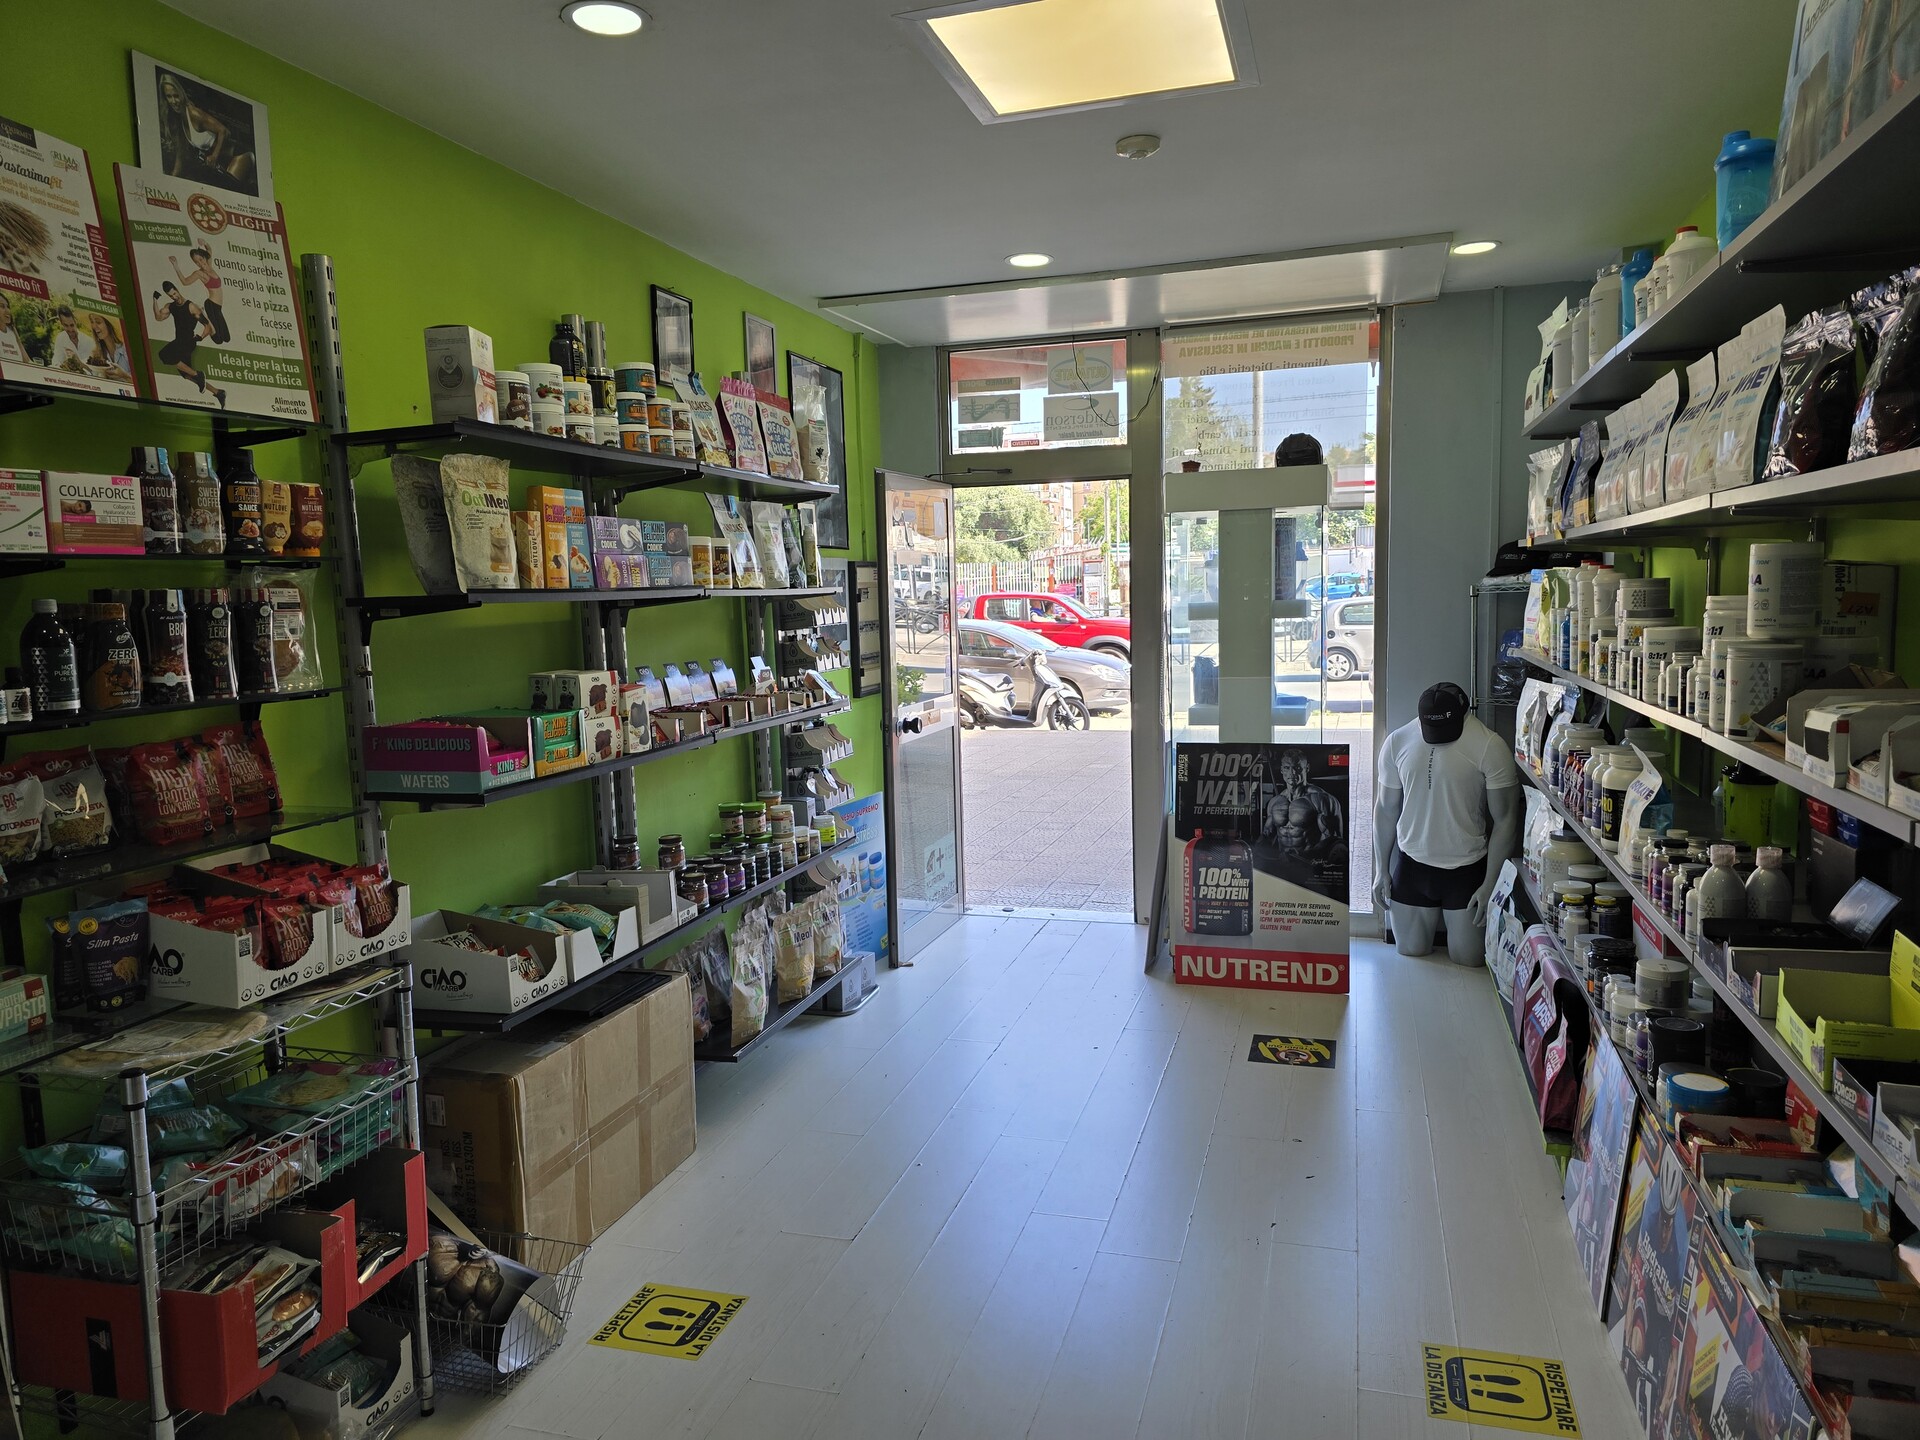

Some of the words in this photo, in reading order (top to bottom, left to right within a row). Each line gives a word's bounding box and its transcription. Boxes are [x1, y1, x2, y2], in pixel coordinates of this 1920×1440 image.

[145, 187, 178, 202] RIMA
[133, 222, 143, 231] ha
[148, 224, 184, 235] carboidrati
[231, 214, 275, 232] LIGHT
[227, 241, 280, 261] Immagina
[213, 257, 246, 273] quanto
[247, 263, 283, 279] sarebbe
[31, 280, 42, 295] fit
[223, 276, 255, 292] meglio
[256, 281, 265, 293] la
[266, 283, 287, 296] vita
[77, 297, 95, 309] ADATTA
[101, 303, 120, 315] VEGANI
[241, 297, 252, 307] se
[253, 298, 262, 309] la
[263, 301, 289, 313] pizza
[260, 316, 293, 331] facesse
[245, 331, 296, 349] dimagrire
[219, 353, 251, 367] Ideale
[253, 359, 270, 372] per
[271, 359, 281, 371] la
[282, 363, 300, 374] tua
[207, 364, 234, 378] linea
[242, 370, 275, 384] forma
[275, 374, 302, 387] fisica
[274, 397, 306, 408] Alimento
[271, 405, 308, 416] Salutistico
[730, 413, 753, 430] CREAM
[766, 421, 791, 438] CREAM
[772, 442, 793, 457] RICE
[59, 484, 135, 500] COLLAFORCE
[238, 504, 258, 512] SAUCE
[264, 503, 287, 511] NUTLOVE
[302, 504, 323, 512] NUTLOVE
[601, 540, 618, 549] COOKIE
[643, 533, 666, 542] DELICIOUS
[647, 543, 663, 552] COOKIE
[654, 577, 671, 585] COOKIE
[208, 627, 228, 639] ZERO
[1648, 651, 1668, 660] 8:1:1
[1446, 711, 1452, 719] F
[415, 738, 471, 751] DELICIOUS
[1199, 753, 1264, 778] 100%
[400, 774, 450, 789] WAFERS
[156, 784, 199, 805] PROTEIN
[1196, 780, 1260, 805] WAY
[158, 801, 178, 816] LOW
[1193, 806, 1203, 815] TO
[1205, 806, 1251, 816] PERFECTION
[1199, 867, 1241, 886] 100%
[1231, 878, 1250, 887] WHEY
[1199, 886, 1250, 900] PROTEIN
[87, 939, 111, 950] Slim
[112, 931, 139, 946] Pasta
[151, 966, 174, 977] CARB
[1181, 955, 1340, 986] NUTREND
[1834, 1080, 1857, 1104] FORGED
[594, 1286, 656, 1342] RISPETTARE
[686, 1342, 707, 1357] LA
[702, 1296, 747, 1344] DISTANZA
[1424, 1346, 1442, 1360] LA
[1426, 1362, 1448, 1415] DISTANZA
[1543, 1361, 1578, 1433] RISPETTARE
